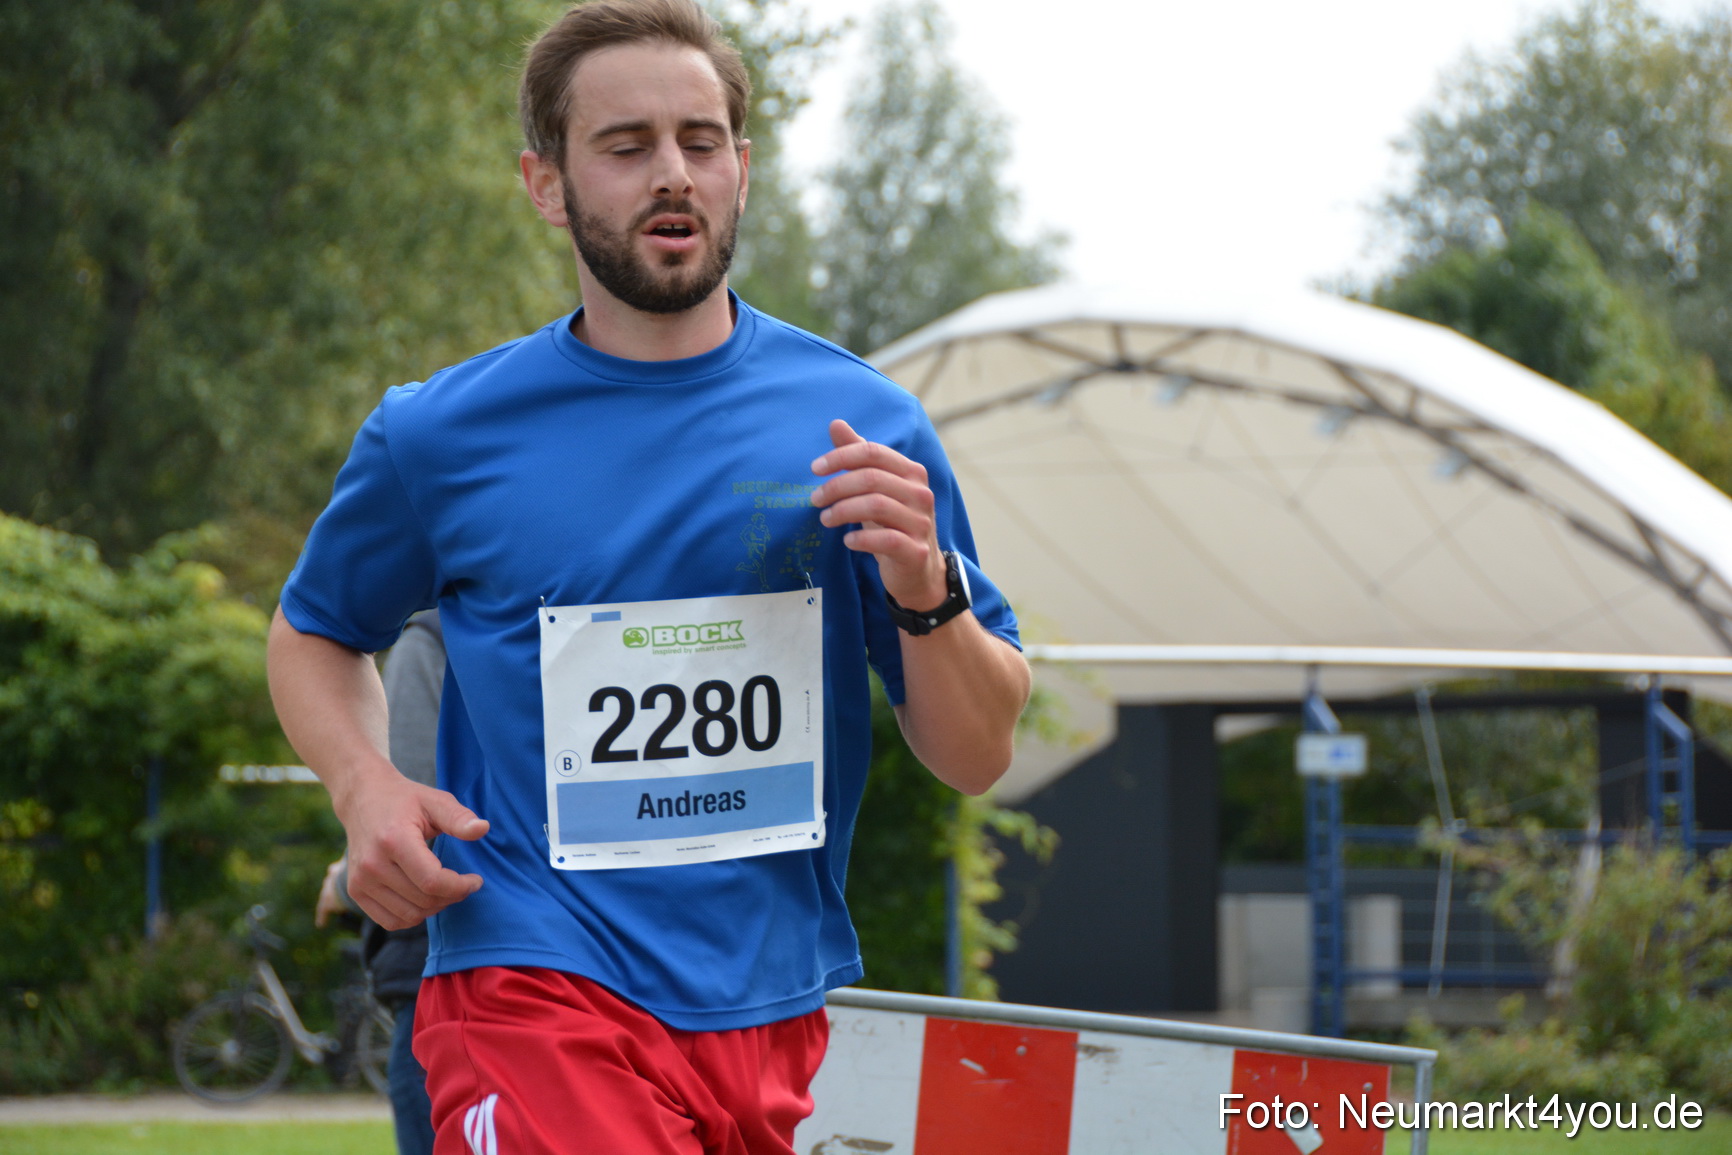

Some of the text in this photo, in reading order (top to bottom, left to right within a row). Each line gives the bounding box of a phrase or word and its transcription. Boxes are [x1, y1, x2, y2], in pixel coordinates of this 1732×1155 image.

[652, 620, 745, 646] BOCK
[652, 647, 682, 655] inspired
[716, 642, 747, 651] concepts
[588, 675, 782, 763] 2280
[563, 758, 572, 771] B
[637, 789, 747, 820] Andreas
